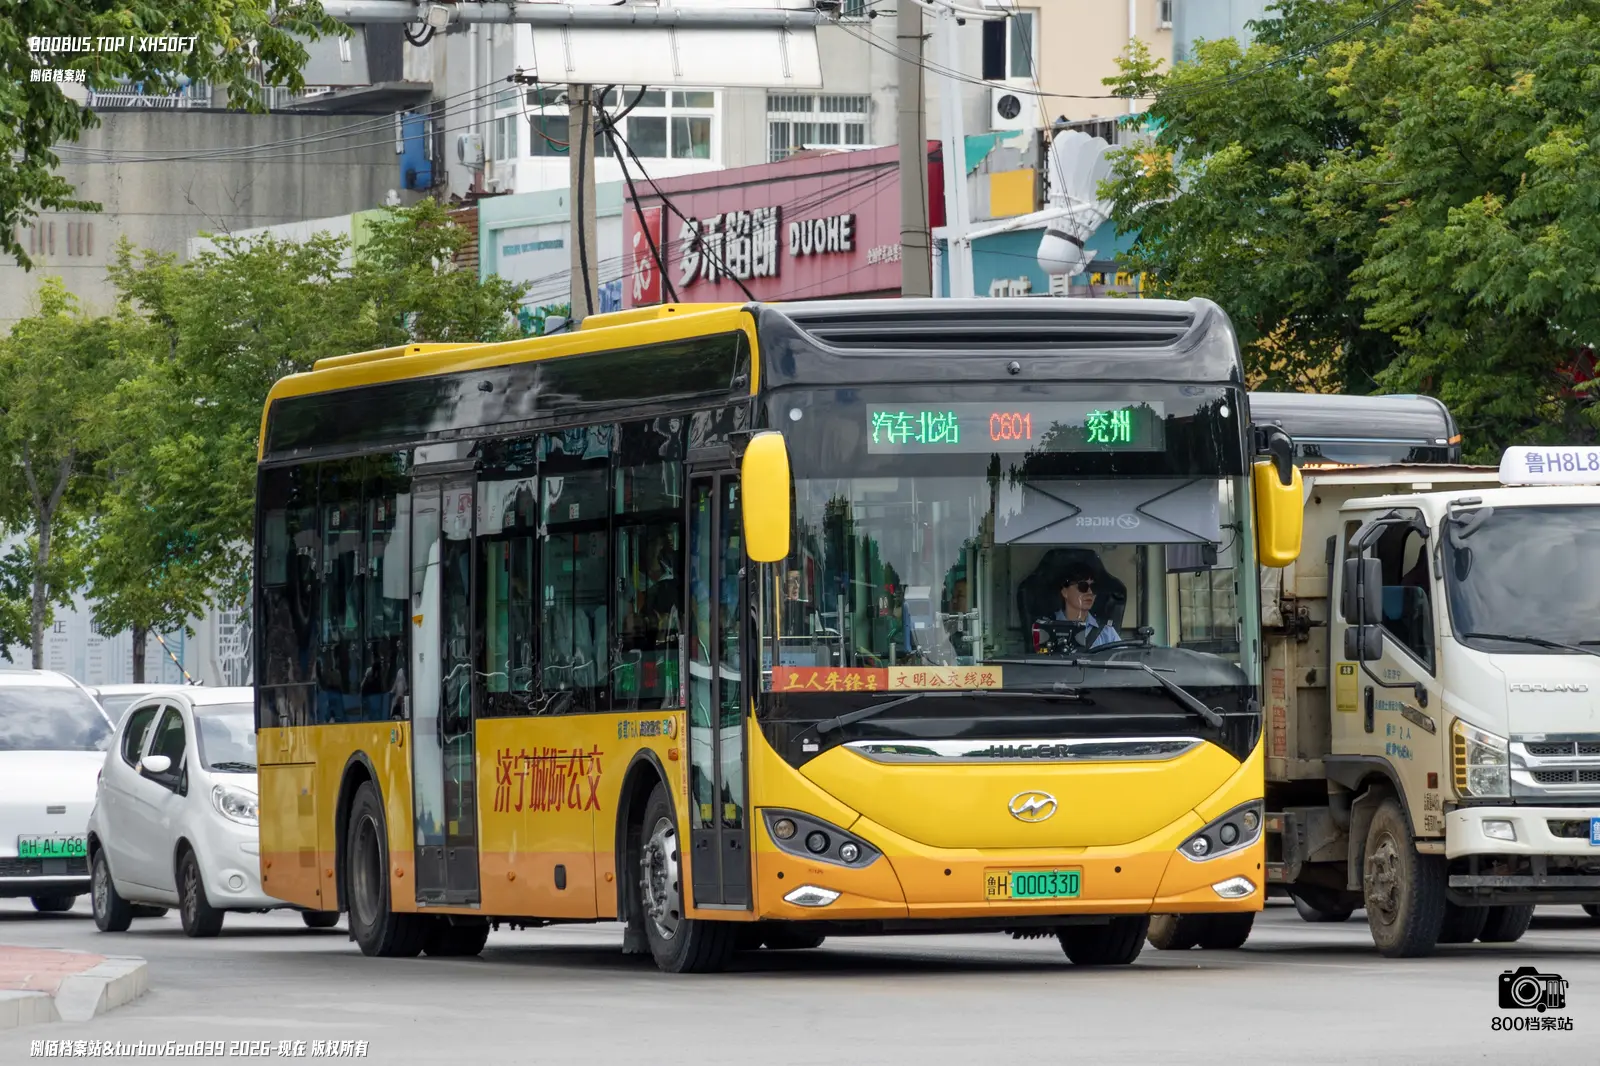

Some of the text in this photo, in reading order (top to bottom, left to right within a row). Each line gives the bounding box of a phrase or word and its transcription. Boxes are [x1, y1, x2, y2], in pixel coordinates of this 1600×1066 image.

[789, 214, 852, 256] DUOHE
[872, 409, 1130, 444] 汽车北站 C601 兖州
[1524, 451, 1600, 474] 鲁H8L8
[895, 671, 997, 688] 文明公交线路
[1509, 682, 1589, 693] FORLAND
[989, 743, 1071, 759] HIGER
[494, 744, 604, 813] 济宁城际公交
